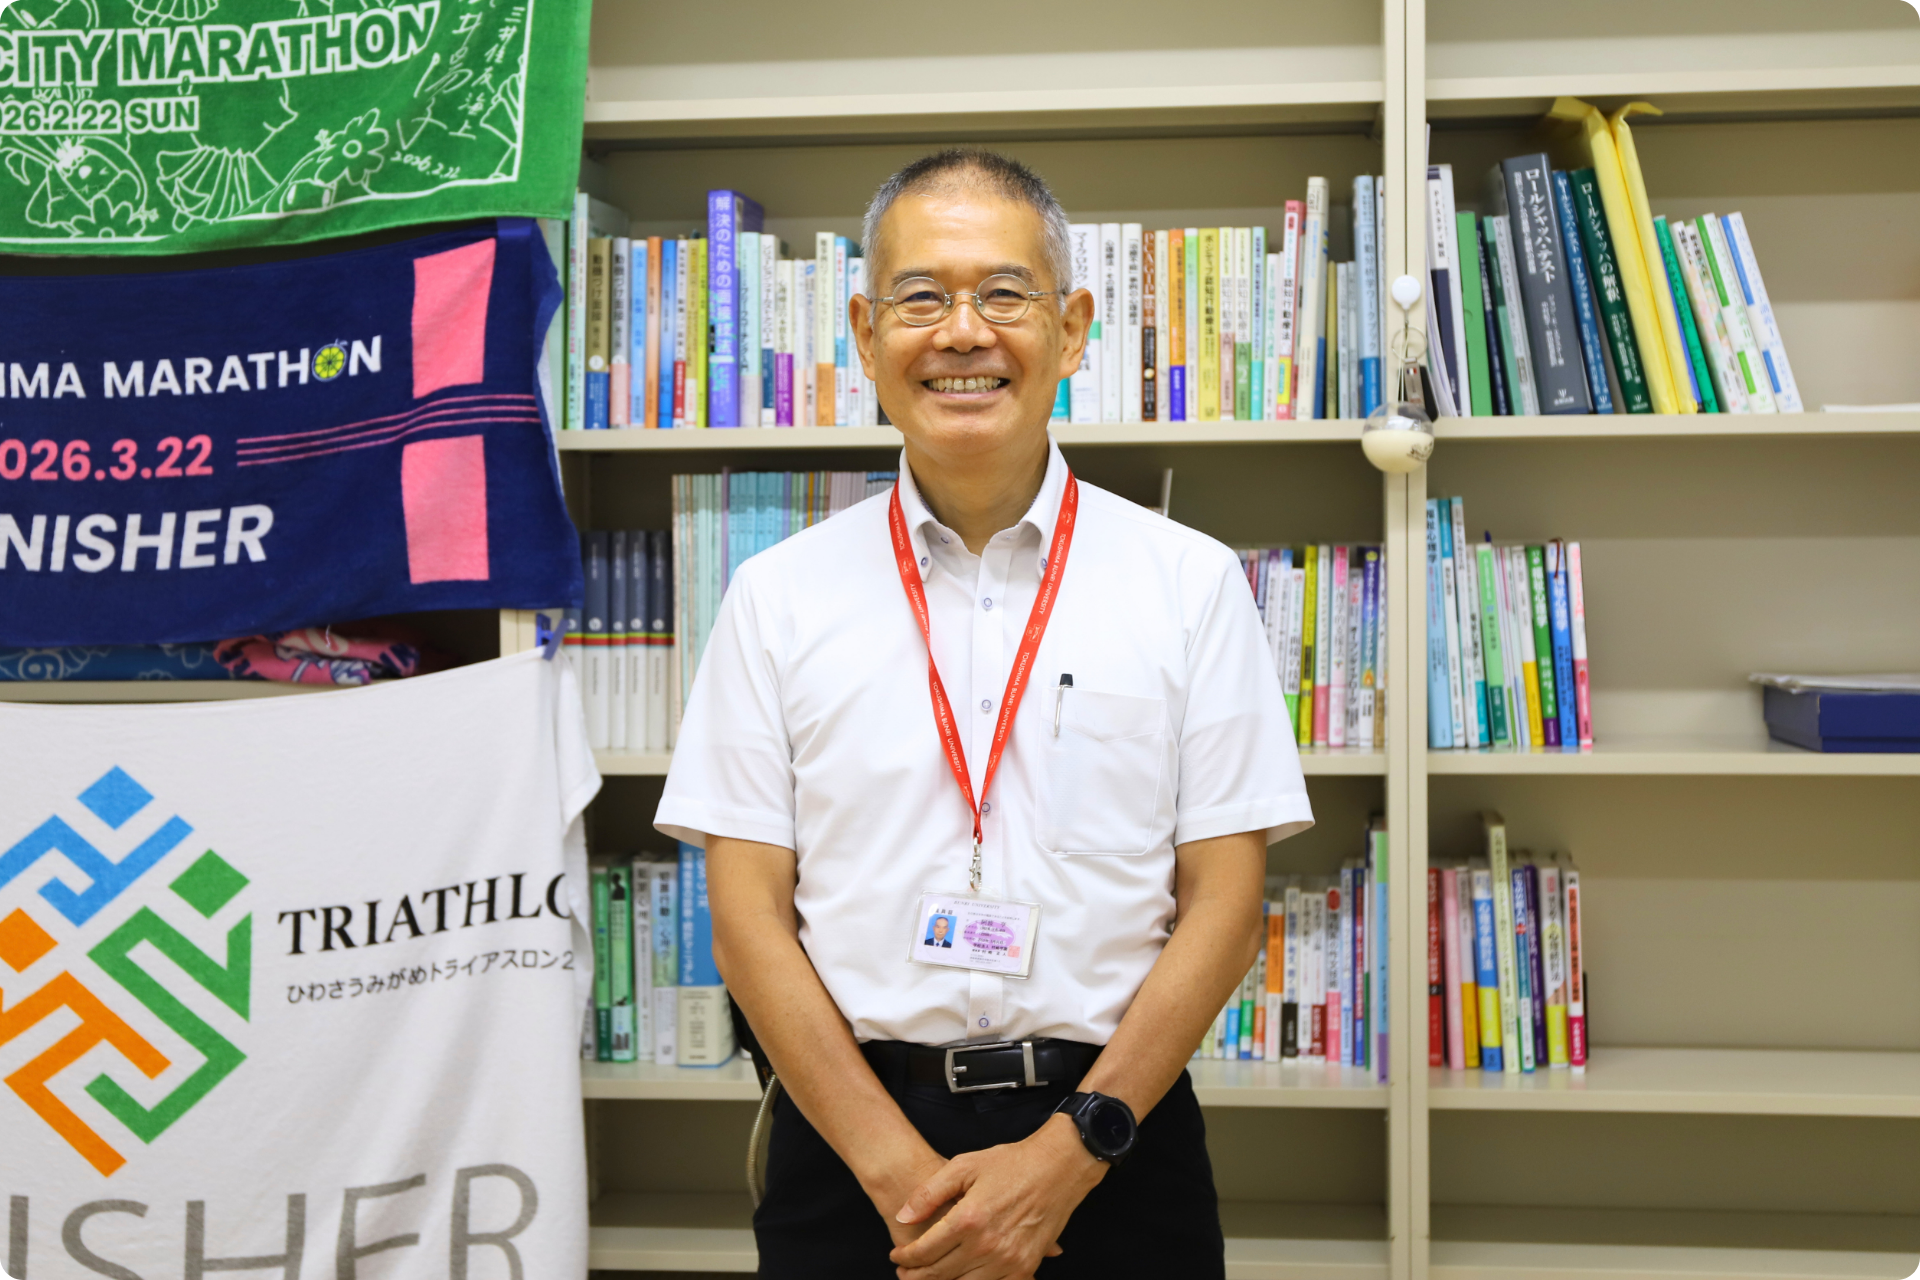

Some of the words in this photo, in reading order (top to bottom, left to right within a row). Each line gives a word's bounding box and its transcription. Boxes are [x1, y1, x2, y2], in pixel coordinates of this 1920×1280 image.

[117, 1, 441, 87] MARATHON
[124, 95, 200, 135] SUN
[1525, 167, 1556, 284] ロールシャッハ・テスト
[1581, 182, 1621, 303] ロールシャッハの解釈
[0, 434, 214, 480] 026.3.22
[0, 503, 275, 573] NISHER
[1053, 533, 1067, 564] TOKUSHIMA
[1426, 508, 1438, 564] 福祉心理学
[1049, 563, 1060, 583] BUNRI
[1038, 582, 1052, 615] UNIVERSITY
[1013, 651, 1030, 687] TOKUSHIMA
[1006, 686, 1020, 708] BUNRI
[932, 681, 946, 717] TOKUSHIMA
[941, 717, 952, 737] BUNRI
[947, 737, 963, 773] UNIVERSITY
[997, 706, 1012, 743] UNIVERSITY
[1478, 901, 1495, 972] 心理学統計法
